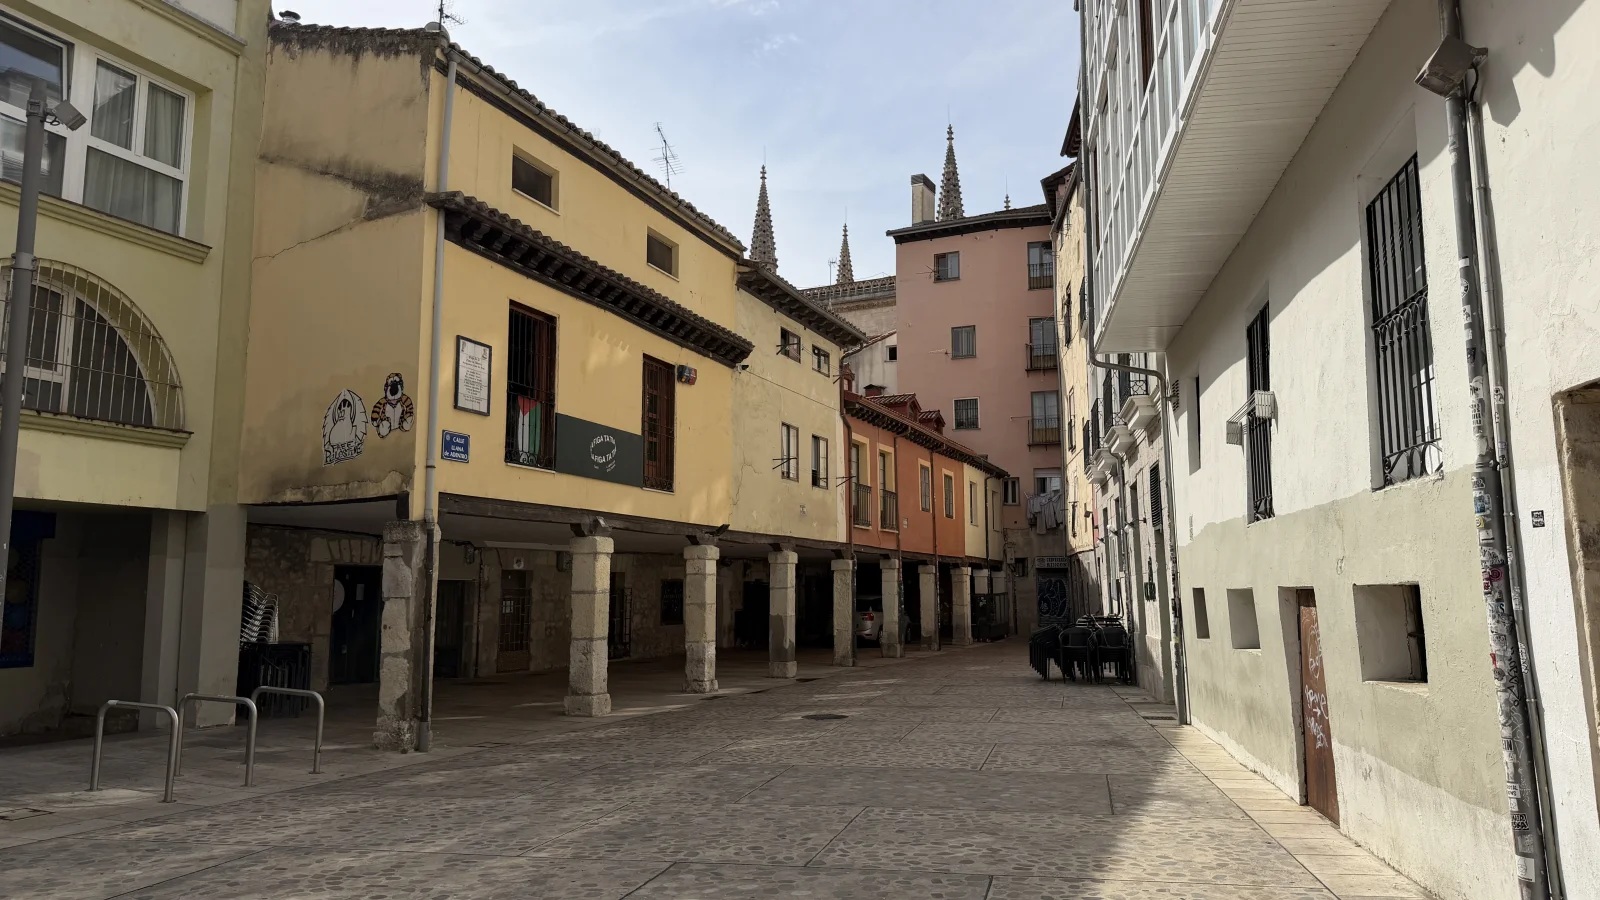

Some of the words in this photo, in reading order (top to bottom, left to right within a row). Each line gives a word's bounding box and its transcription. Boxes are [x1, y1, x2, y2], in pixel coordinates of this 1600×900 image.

[452, 436, 465, 445] CALLE
[451, 445, 465, 453] LLANA
[449, 451, 468, 460] ADENTRO
